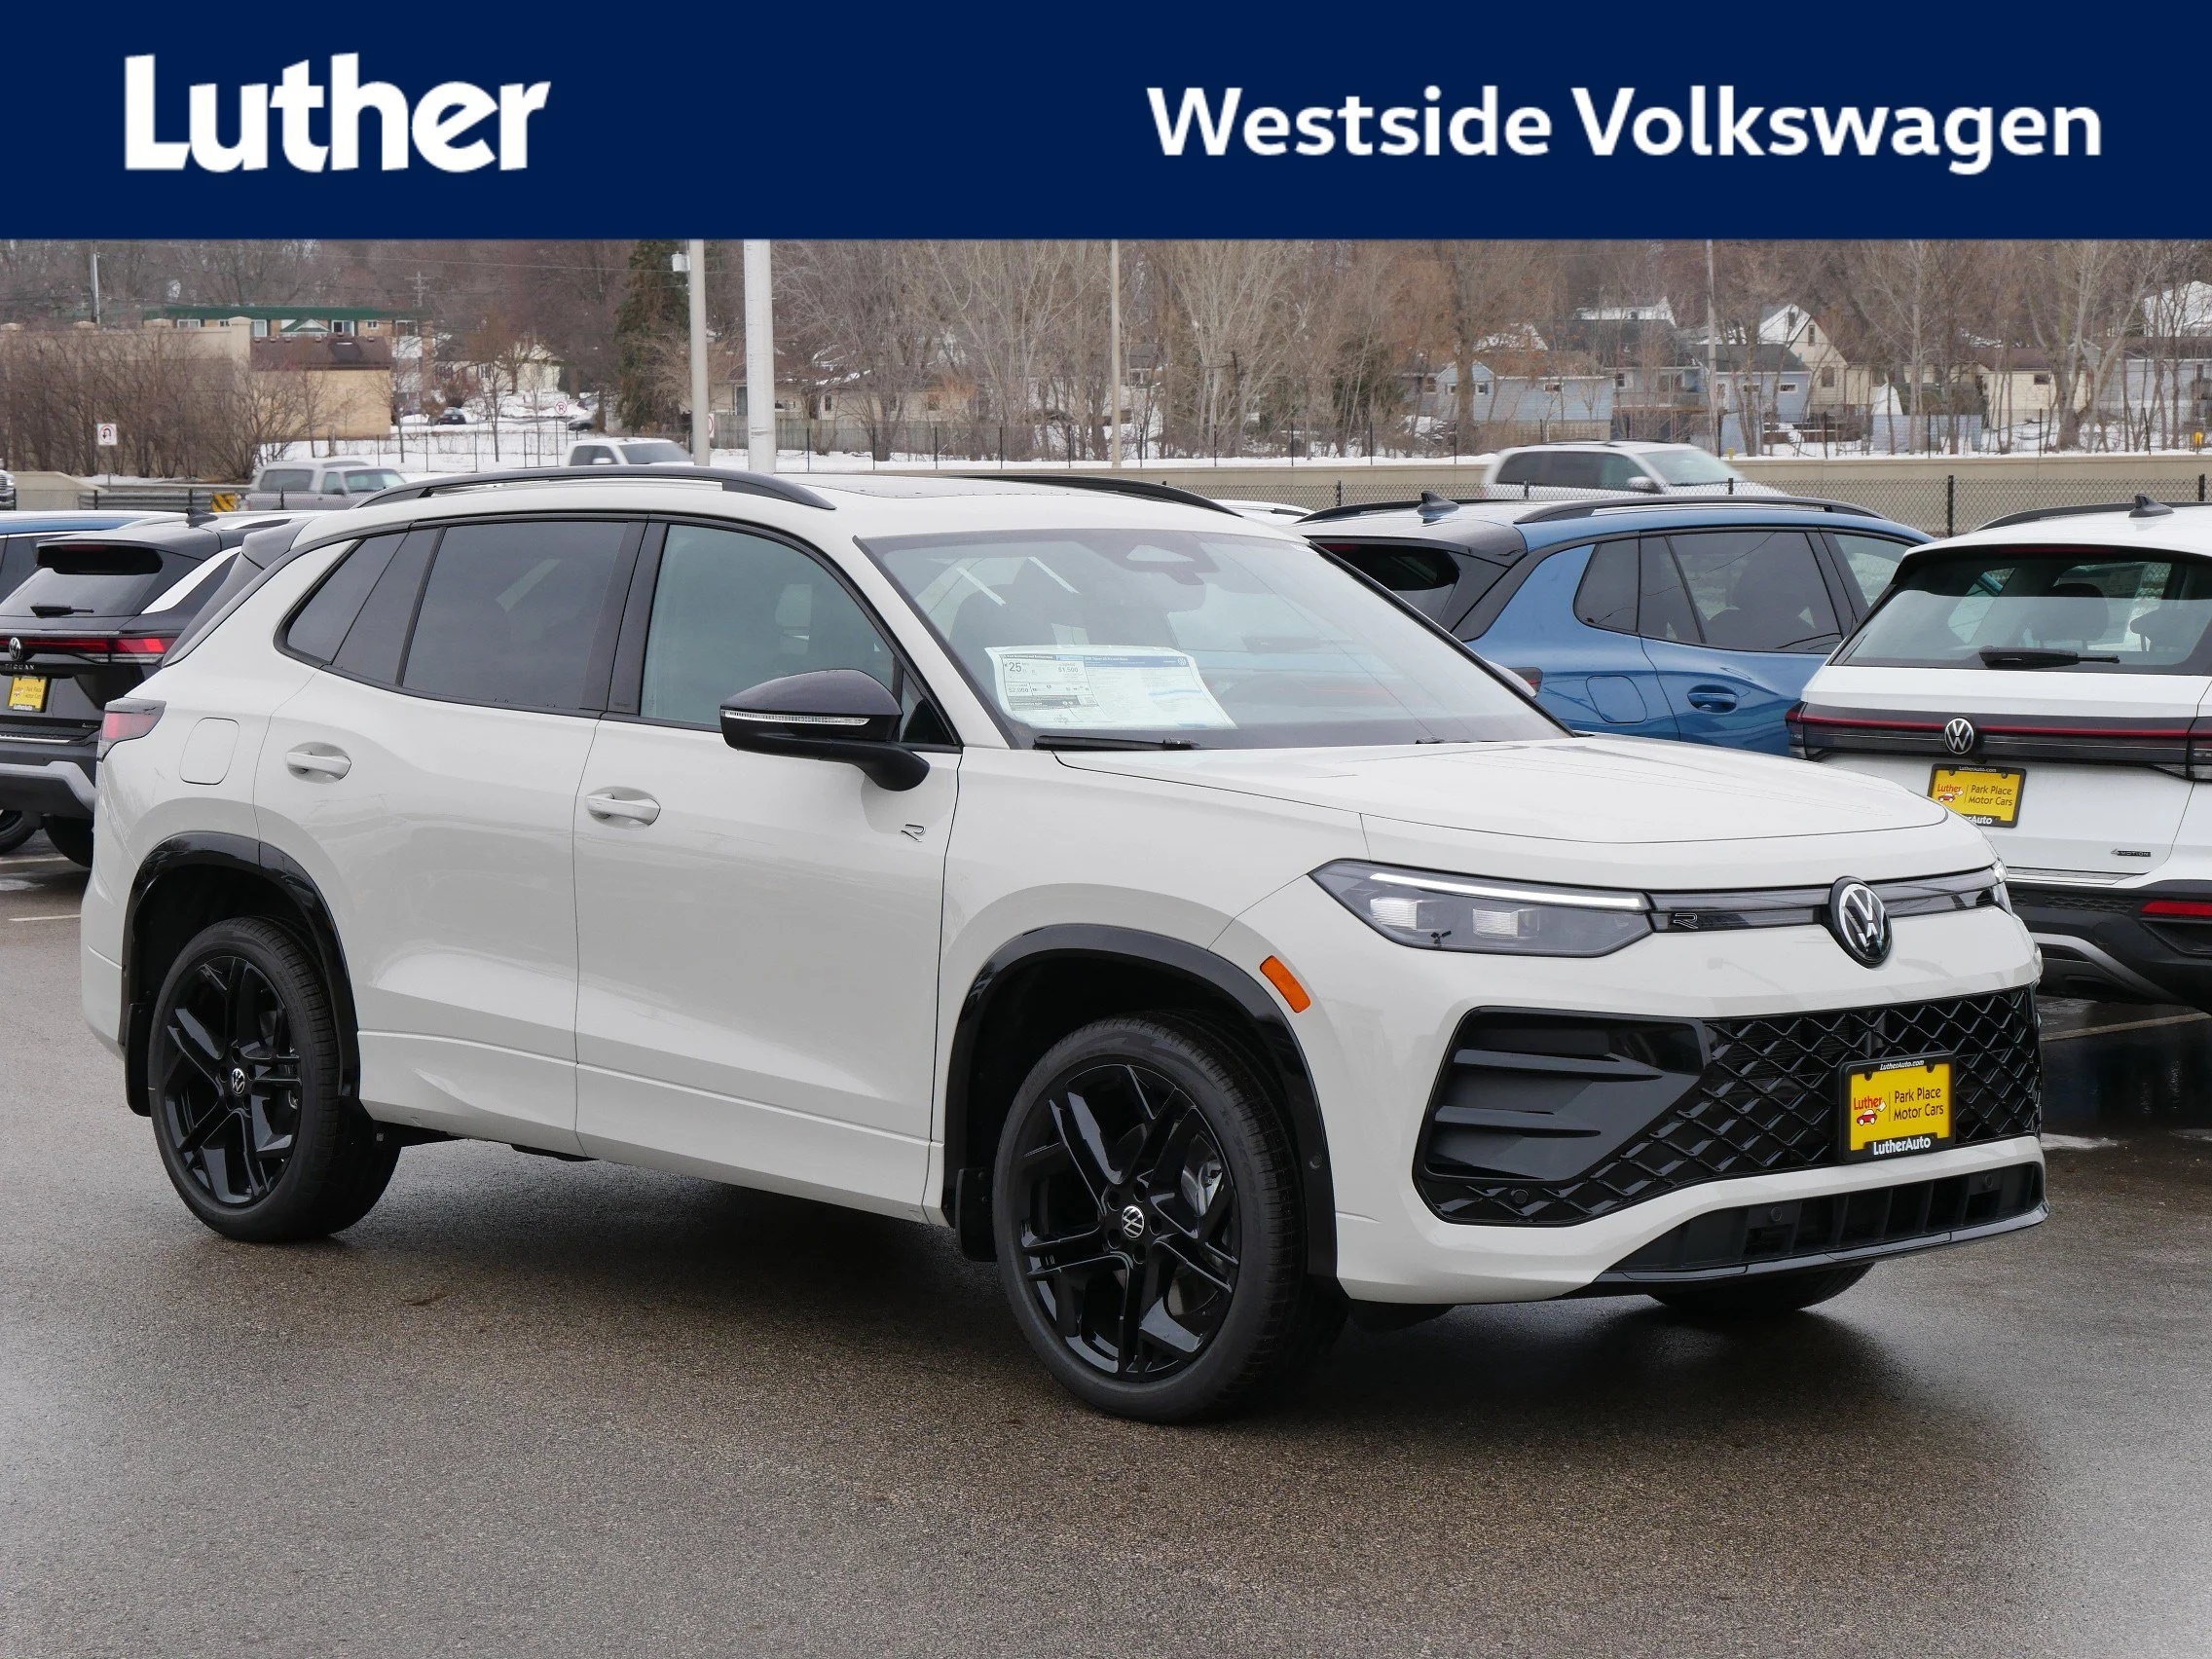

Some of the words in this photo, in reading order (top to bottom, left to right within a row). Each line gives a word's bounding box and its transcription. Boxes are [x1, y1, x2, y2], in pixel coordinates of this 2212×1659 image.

[1009, 661, 1022, 673] 25
[1936, 784, 1962, 793] Luther
[1971, 785, 1989, 794] Park
[1990, 786, 2012, 795] Place
[1968, 795, 1994, 805] Motor
[1995, 796, 2013, 806] Cars
[1879, 1059, 1925, 1071] LutherAuto.com
[1895, 1089, 1914, 1103] Park
[1917, 1087, 1941, 1100] Place
[1853, 1095, 1883, 1111] Luther
[1894, 1106, 1922, 1121] Motor
[1924, 1103, 1944, 1117] Cars
[1873, 1136, 1932, 1156] LutherAuto
